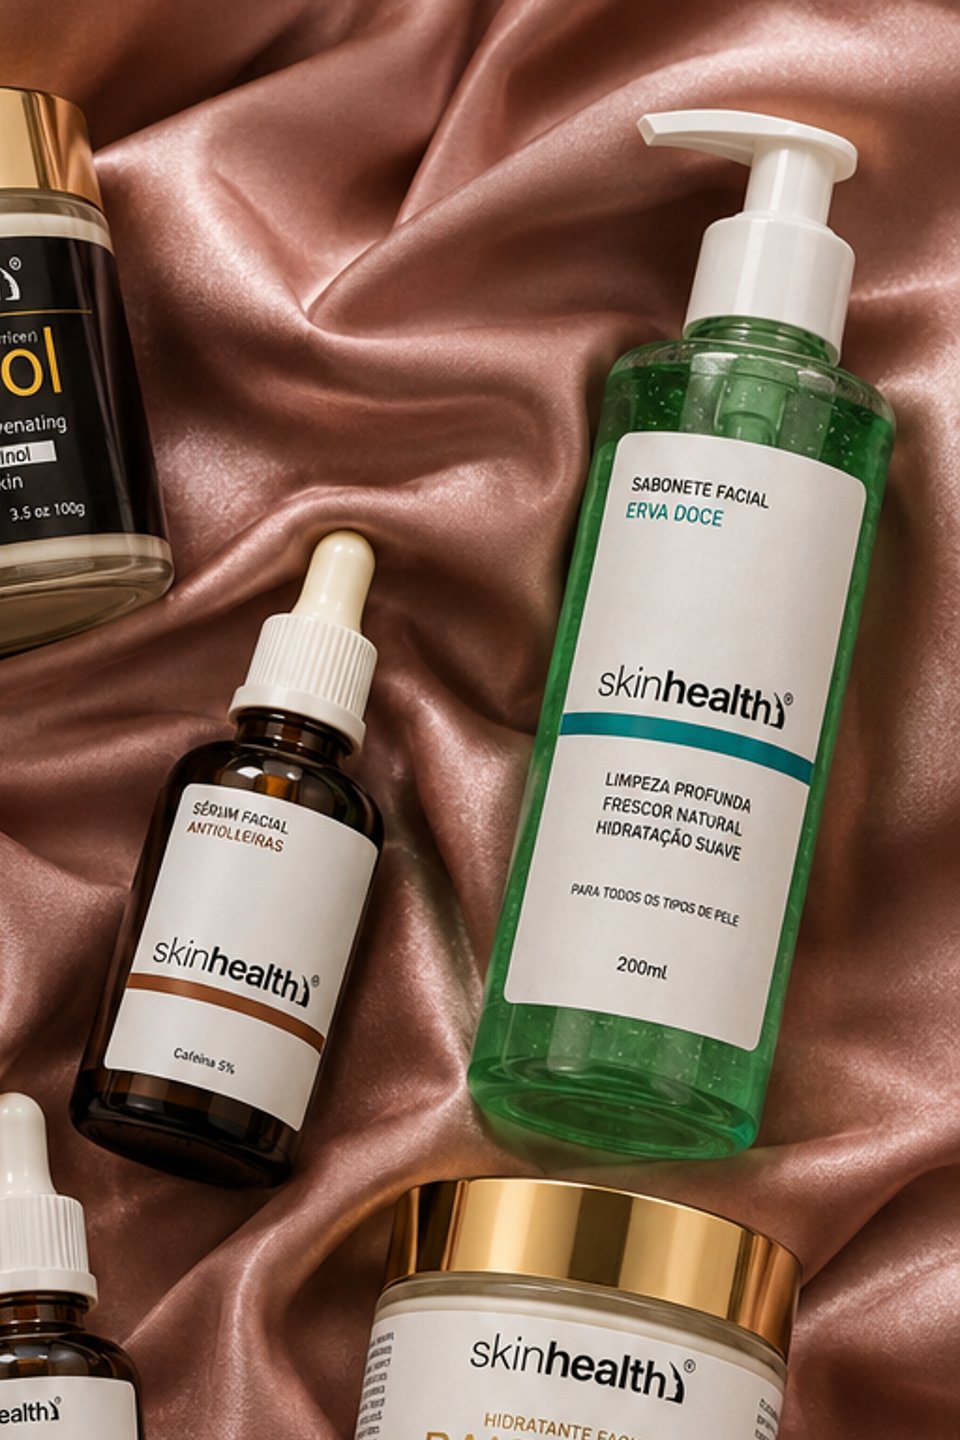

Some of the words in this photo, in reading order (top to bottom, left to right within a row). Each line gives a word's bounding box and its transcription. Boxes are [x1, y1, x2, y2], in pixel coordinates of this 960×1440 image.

[632, 476, 712, 497] SABONETE
[716, 484, 769, 509] FACIAL
[9, 506, 31, 521] 3.5
[55, 501, 85, 517] 100g
[625, 502, 668, 520] ERVA
[674, 503, 724, 527] DOCE
[605, 772, 670, 795] LIMPEZA
[674, 781, 751, 814] PROFUNDA
[241, 811, 288, 835] FACIAL
[602, 796, 673, 819] FRESCOR
[676, 807, 743, 837] NATURAL
[596, 820, 692, 848] HIDRATAÇÃO
[695, 836, 742, 862] SUAVE
[571, 883, 600, 897] PARA
[603, 886, 642, 904] TODOS
[644, 894, 660, 907] OS
[663, 897, 695, 915] TIPOS
[697, 904, 714, 919] DE
[714, 908, 740, 927] PELE
[616, 956, 668, 980] 200ml
